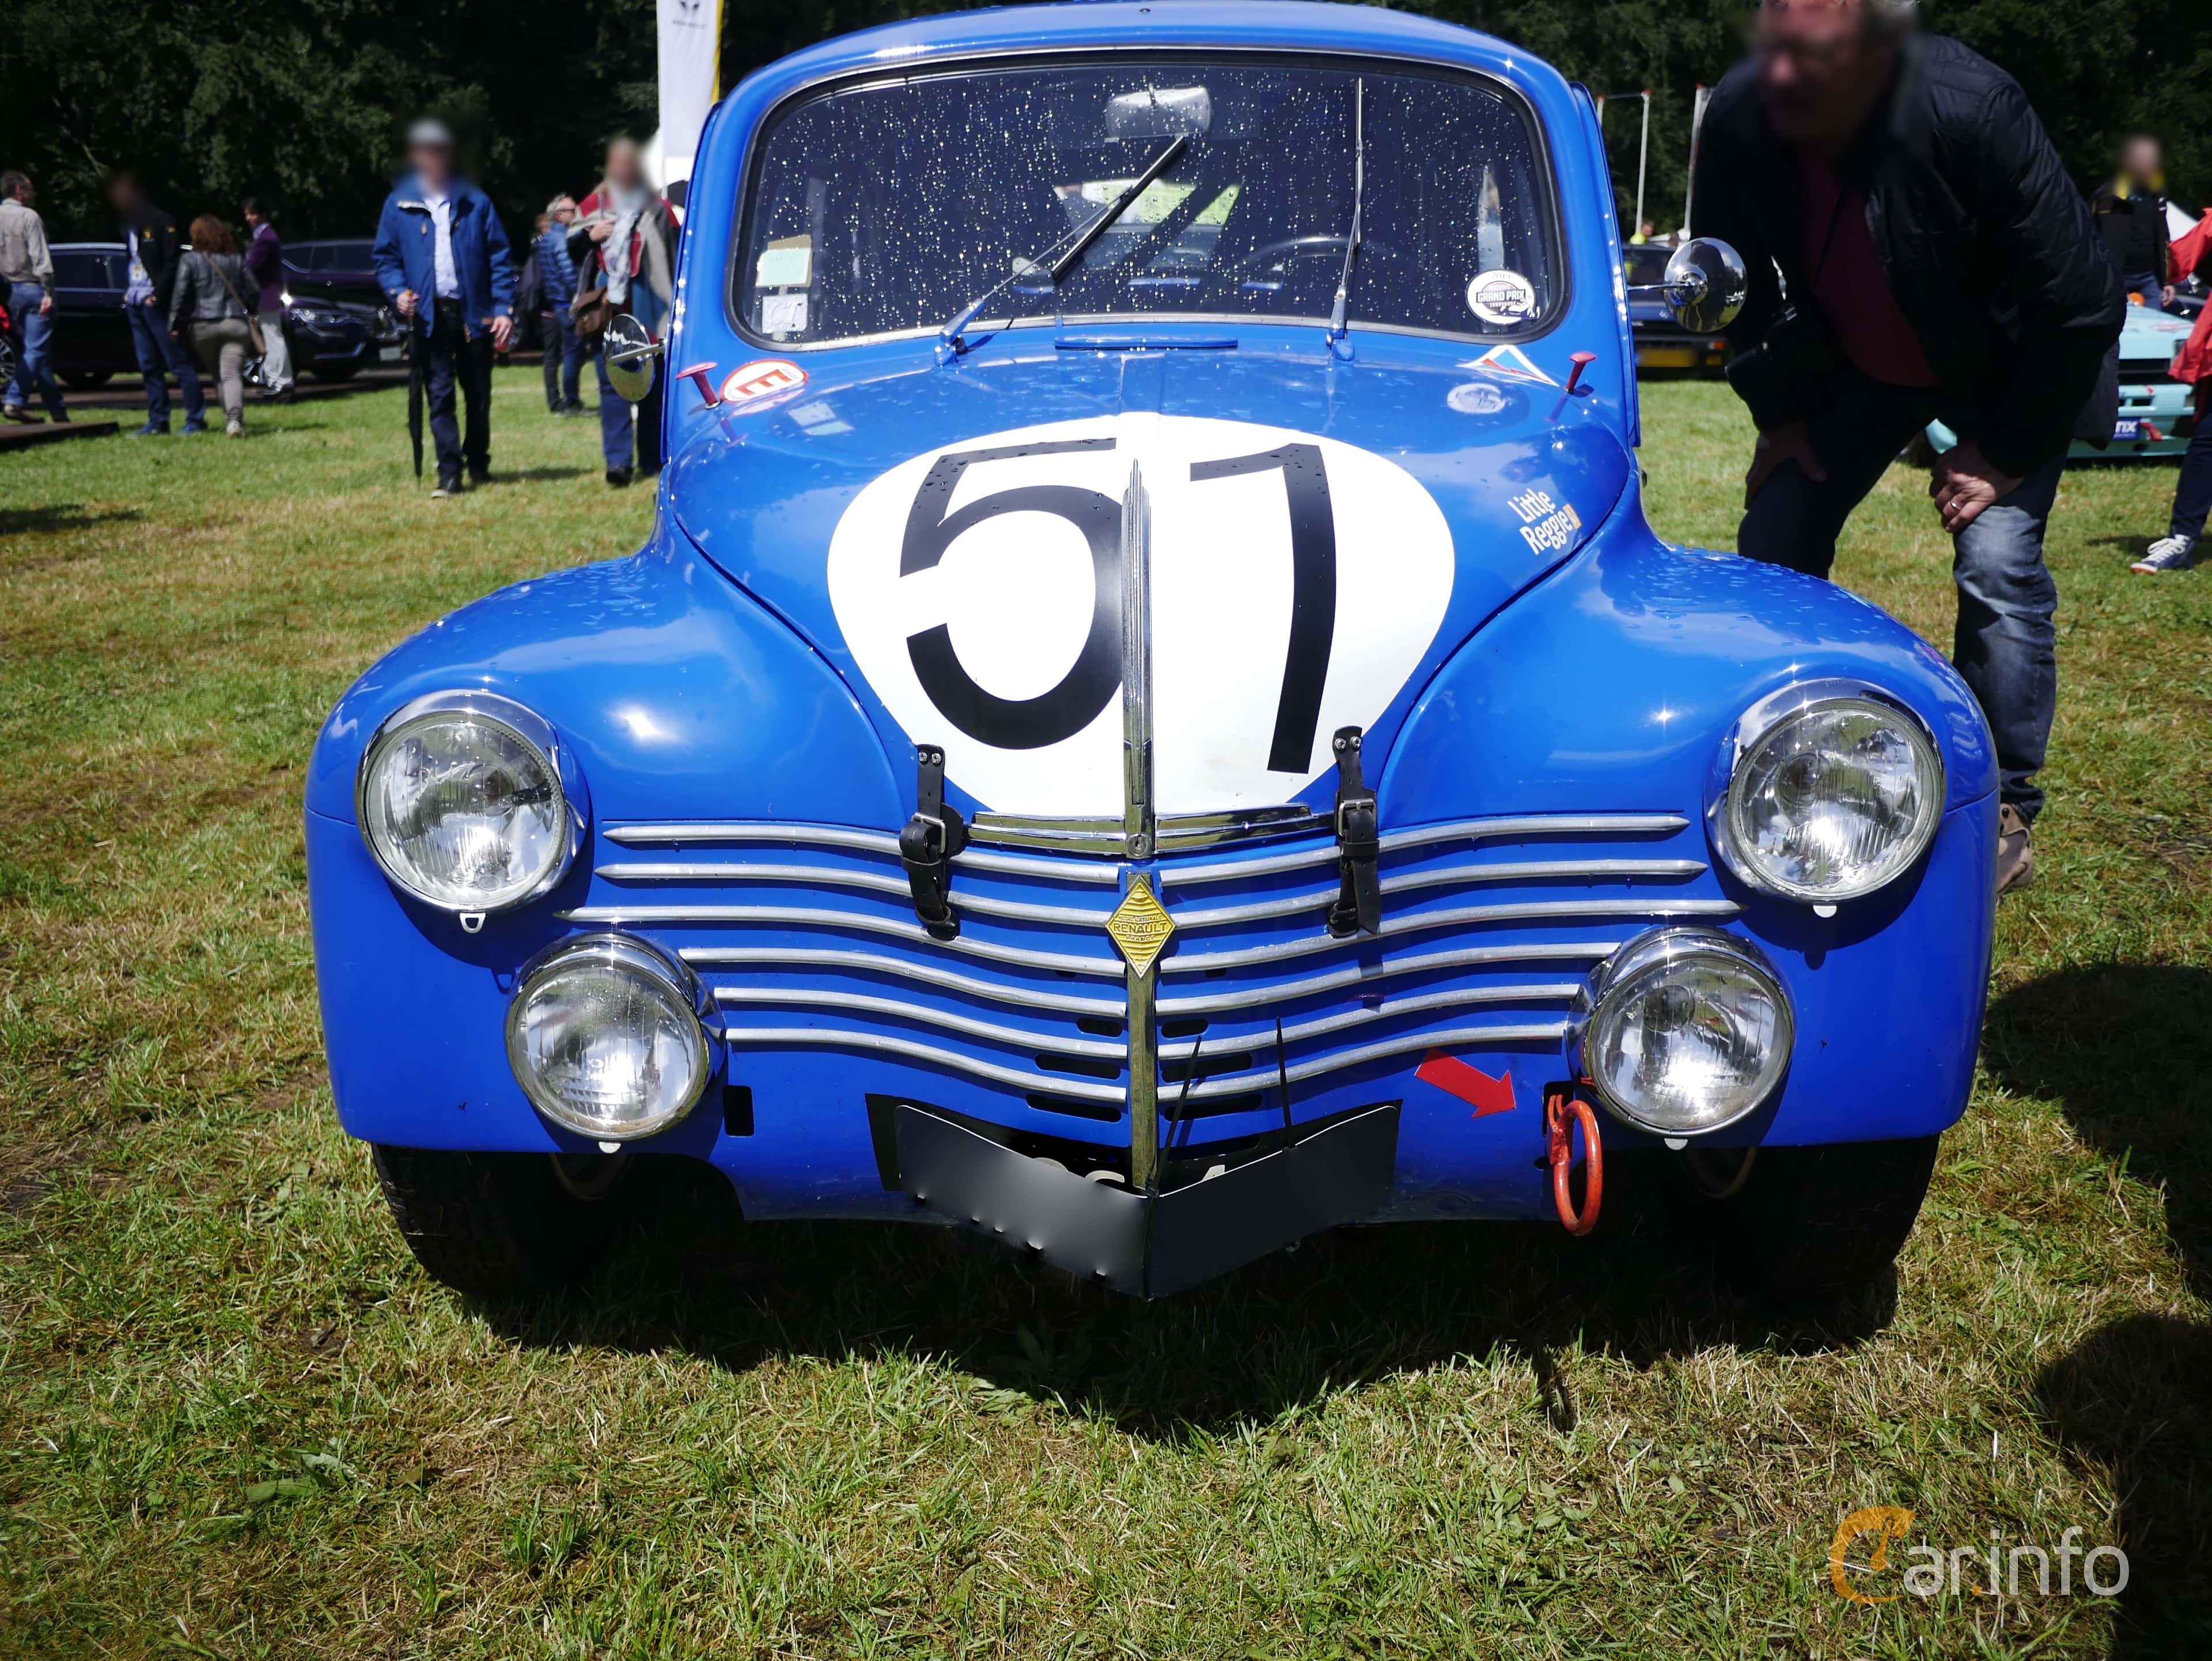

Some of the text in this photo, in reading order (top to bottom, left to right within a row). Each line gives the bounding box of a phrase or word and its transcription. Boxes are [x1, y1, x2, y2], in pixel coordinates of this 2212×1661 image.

[1477, 290, 1525, 302] GRAND PRIX
[1507, 488, 1556, 524] Little
[1519, 510, 1573, 555] Reggie
[1113, 922, 1166, 933] RENAULT
